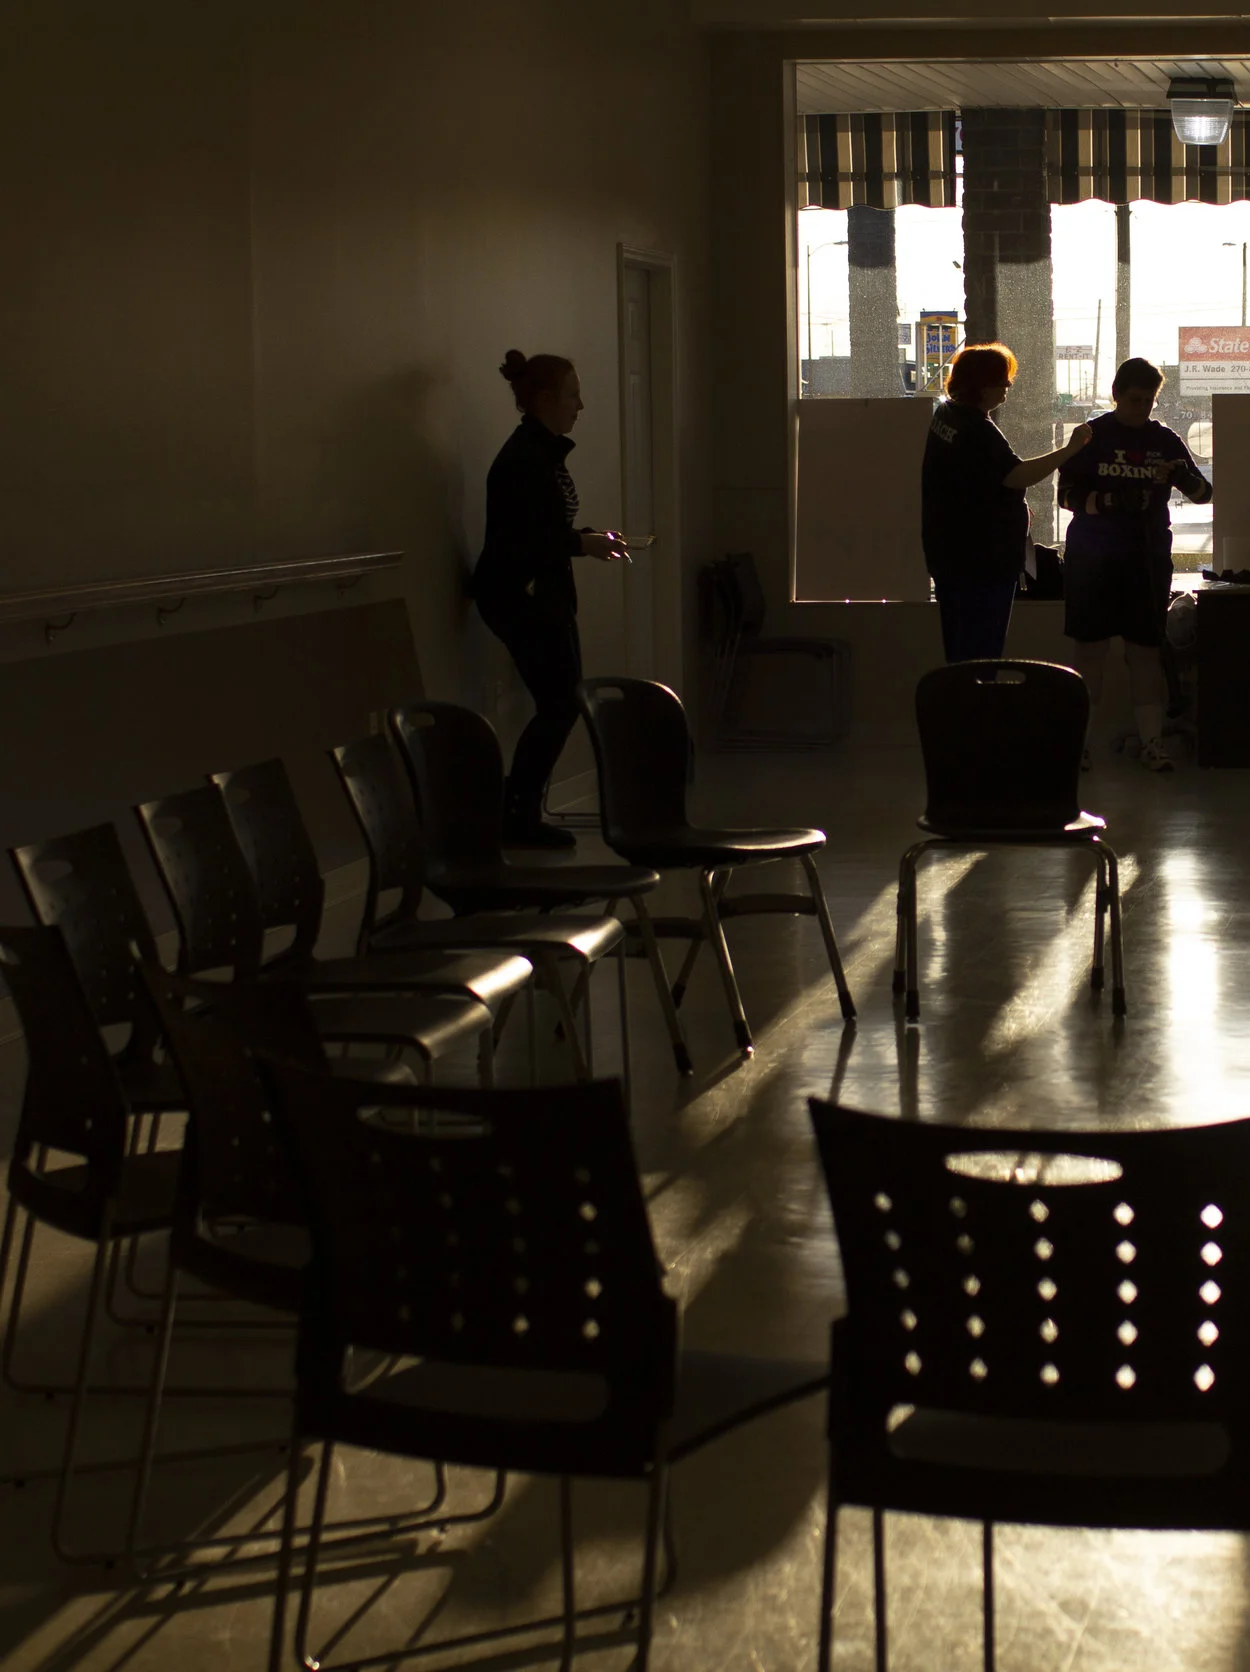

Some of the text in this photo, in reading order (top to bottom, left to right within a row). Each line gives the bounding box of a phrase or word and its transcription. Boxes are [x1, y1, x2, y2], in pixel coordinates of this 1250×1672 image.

[1184, 365, 1200, 373] J.R.
[1202, 365, 1226, 373] Wade
[1112, 449, 1127, 464] I
